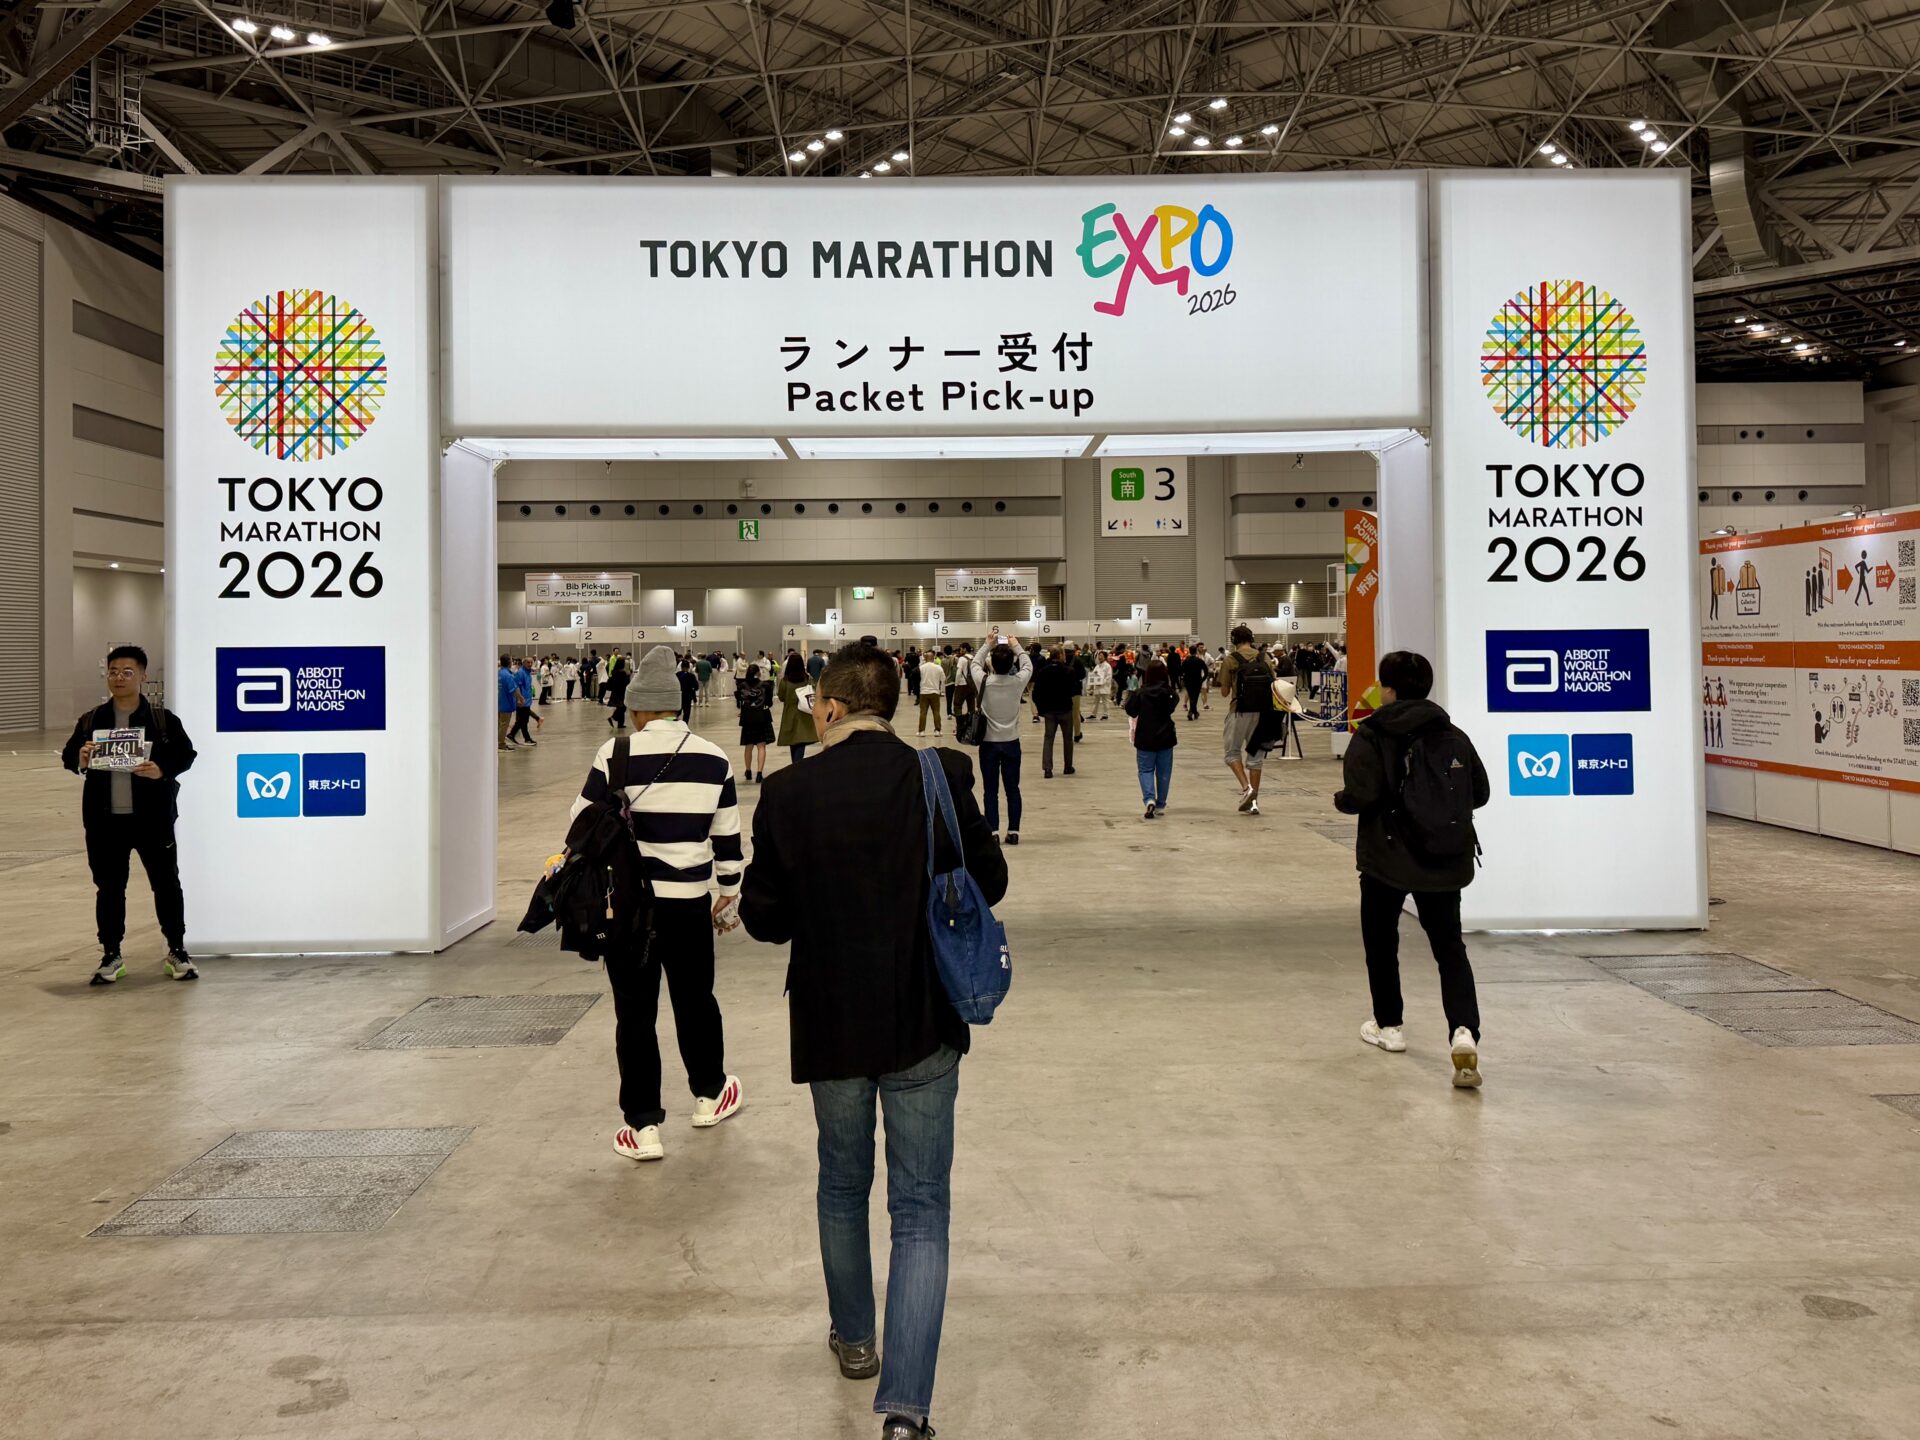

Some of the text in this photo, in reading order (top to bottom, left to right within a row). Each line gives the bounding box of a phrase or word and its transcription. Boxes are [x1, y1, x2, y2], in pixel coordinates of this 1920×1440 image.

[639, 202, 1234, 317] TOKYO MARATHON EXPO
[1187, 283, 1237, 316] 2026
[780, 331, 1093, 373] ランナー受付
[787, 380, 1094, 417] Packet Pick-up
[1119, 472, 1137, 481] South
[1485, 463, 1645, 498] TOKYO
[1120, 480, 1135, 498] 南
[1154, 467, 1175, 501] 3
[218, 477, 384, 512] TOKYO
[1488, 506, 1643, 528] MARATHON
[220, 521, 381, 542] MARATHON
[1353, 524, 1377, 546] POINT
[1822, 527, 1836, 536] Thank
[1487, 536, 1646, 583] 2026
[218, 551, 383, 599] 2026
[988, 577, 1016, 586] Pick-up
[581, 583, 610, 591] Pick-up
[932, 610, 940, 620] 5
[1034, 609, 1042, 619] 6
[1136, 607, 1144, 617] 7
[1283, 606, 1291, 616] 8
[575, 615, 584, 625] 2
[681, 614, 689, 624] 3
[829, 612, 838, 622] 4
[838, 626, 846, 636] 4
[890, 625, 898, 635] 5
[941, 625, 949, 635] 5
[1042, 624, 1050, 634] 6
[1093, 622, 1101, 632] 7
[1144, 622, 1152, 632] 7
[1291, 621, 1299, 631] 8
[531, 631, 539, 641] 2
[584, 630, 592, 640] 2
[637, 630, 645, 639] 3
[689, 628, 697, 638] 3
[787, 627, 795, 637] 4
[1564, 649, 1610, 660] ABBOTT
[1564, 661, 1608, 671] WORLD
[1825, 655, 1839, 664] Thank
[1839, 657, 1848, 667] you
[1867, 656, 1879, 668] good
[296, 667, 345, 678] ABBOTT
[1564, 671, 1631, 682] MARATHON
[296, 679, 342, 690] WORLD
[1564, 682, 1612, 692] MAJORS
[296, 689, 366, 700] MARATHON
[296, 701, 345, 712] MAJORS
[106, 741, 135, 757] 14601
[1577, 759, 1628, 769] 東京メトロ
[1893, 758, 1906, 766] START
[308, 779, 361, 790] 東京メトロ
